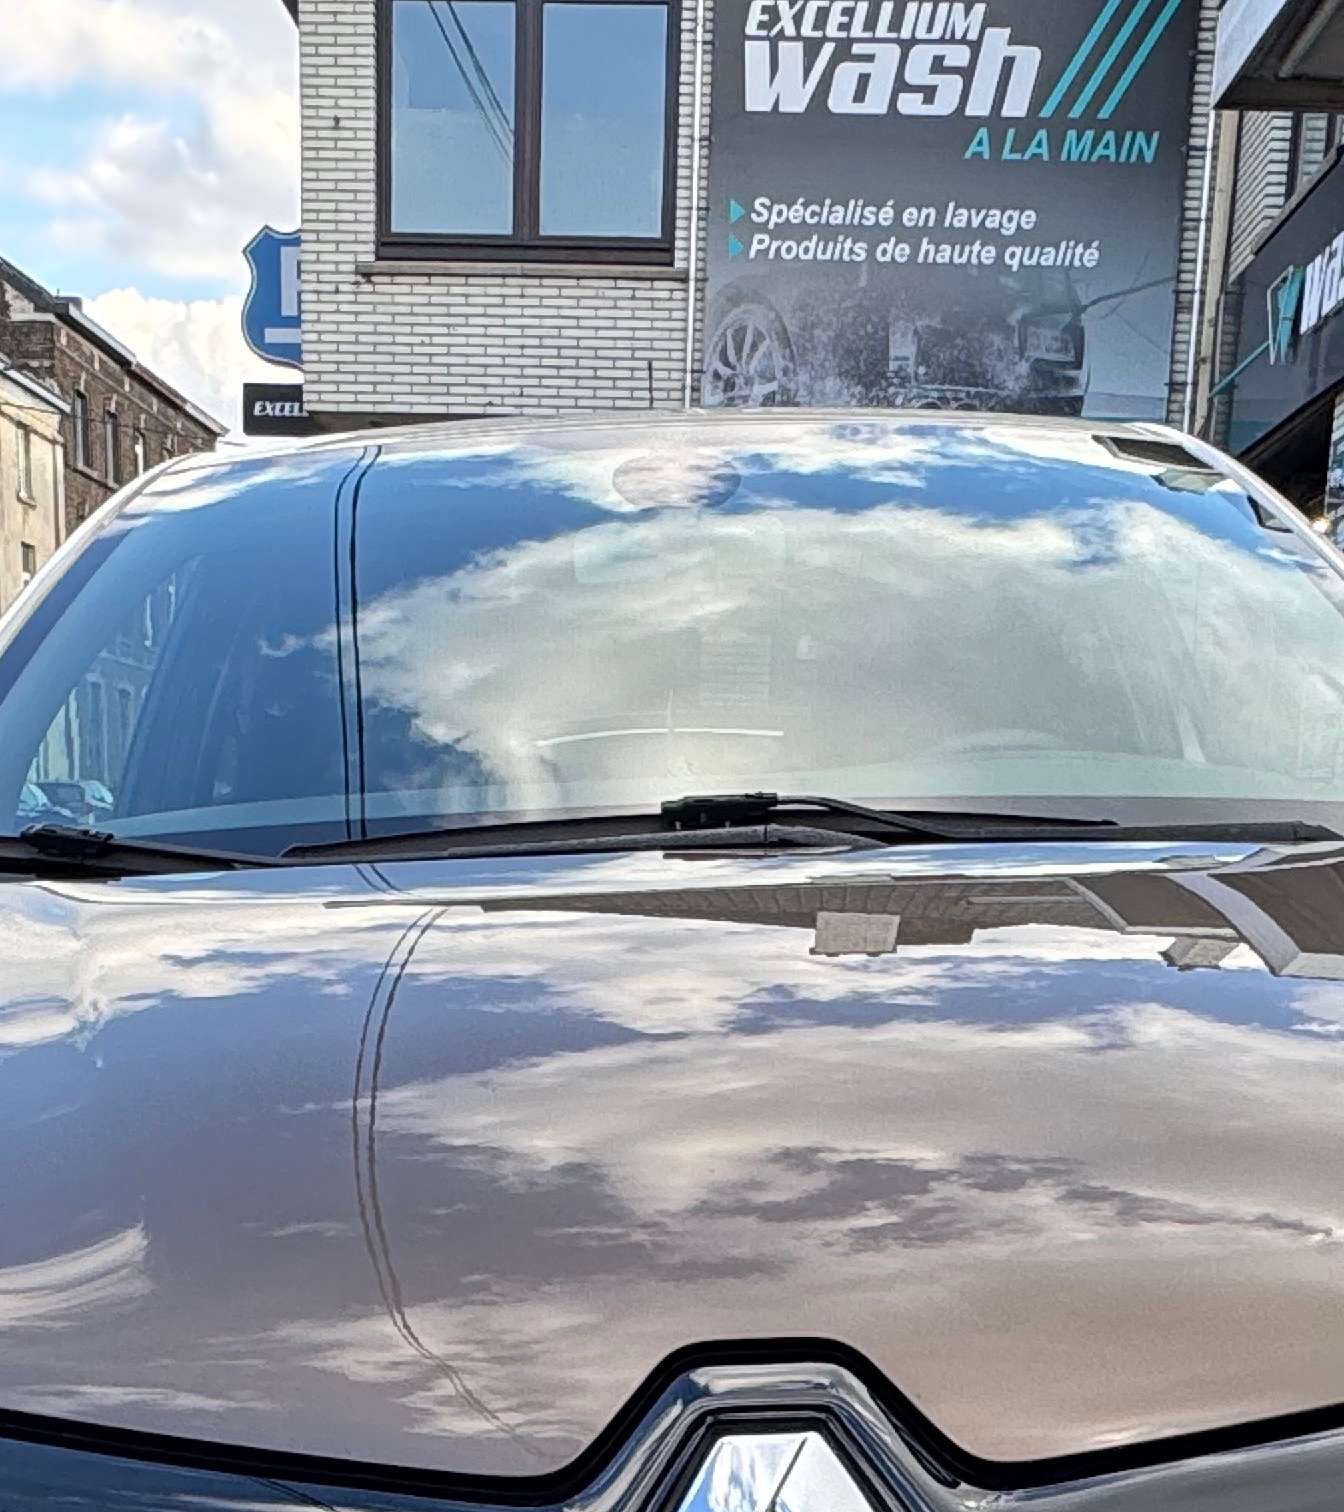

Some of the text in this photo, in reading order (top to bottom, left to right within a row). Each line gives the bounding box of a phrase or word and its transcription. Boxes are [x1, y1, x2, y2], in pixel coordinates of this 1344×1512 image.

[745, 0, 987, 41] EXCELLIUM
[964, 126, 1160, 164] A LA MAIN
[750, 198, 1037, 236] Spécialisé en lavage
[748, 234, 1102, 272] Produits de haute qualité
